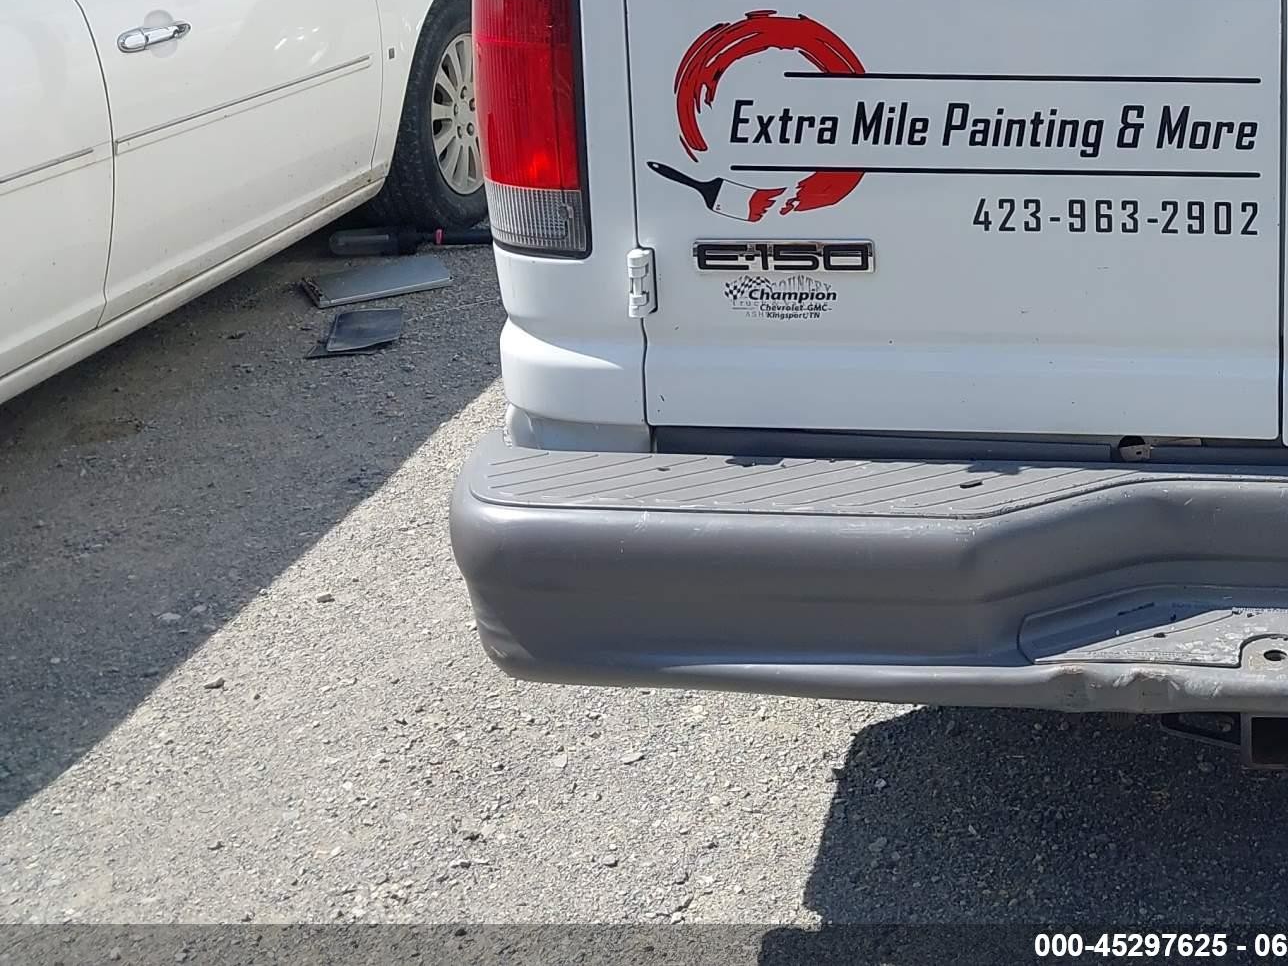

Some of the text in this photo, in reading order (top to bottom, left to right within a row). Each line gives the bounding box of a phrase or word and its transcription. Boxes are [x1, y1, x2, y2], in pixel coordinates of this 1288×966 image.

[730, 99, 1258, 158] Extra Mile Painting & More
[972, 198, 1258, 236] 423-963-2902
[748, 288, 837, 304] Champion
[760, 303, 803, 312] Chevrolet
